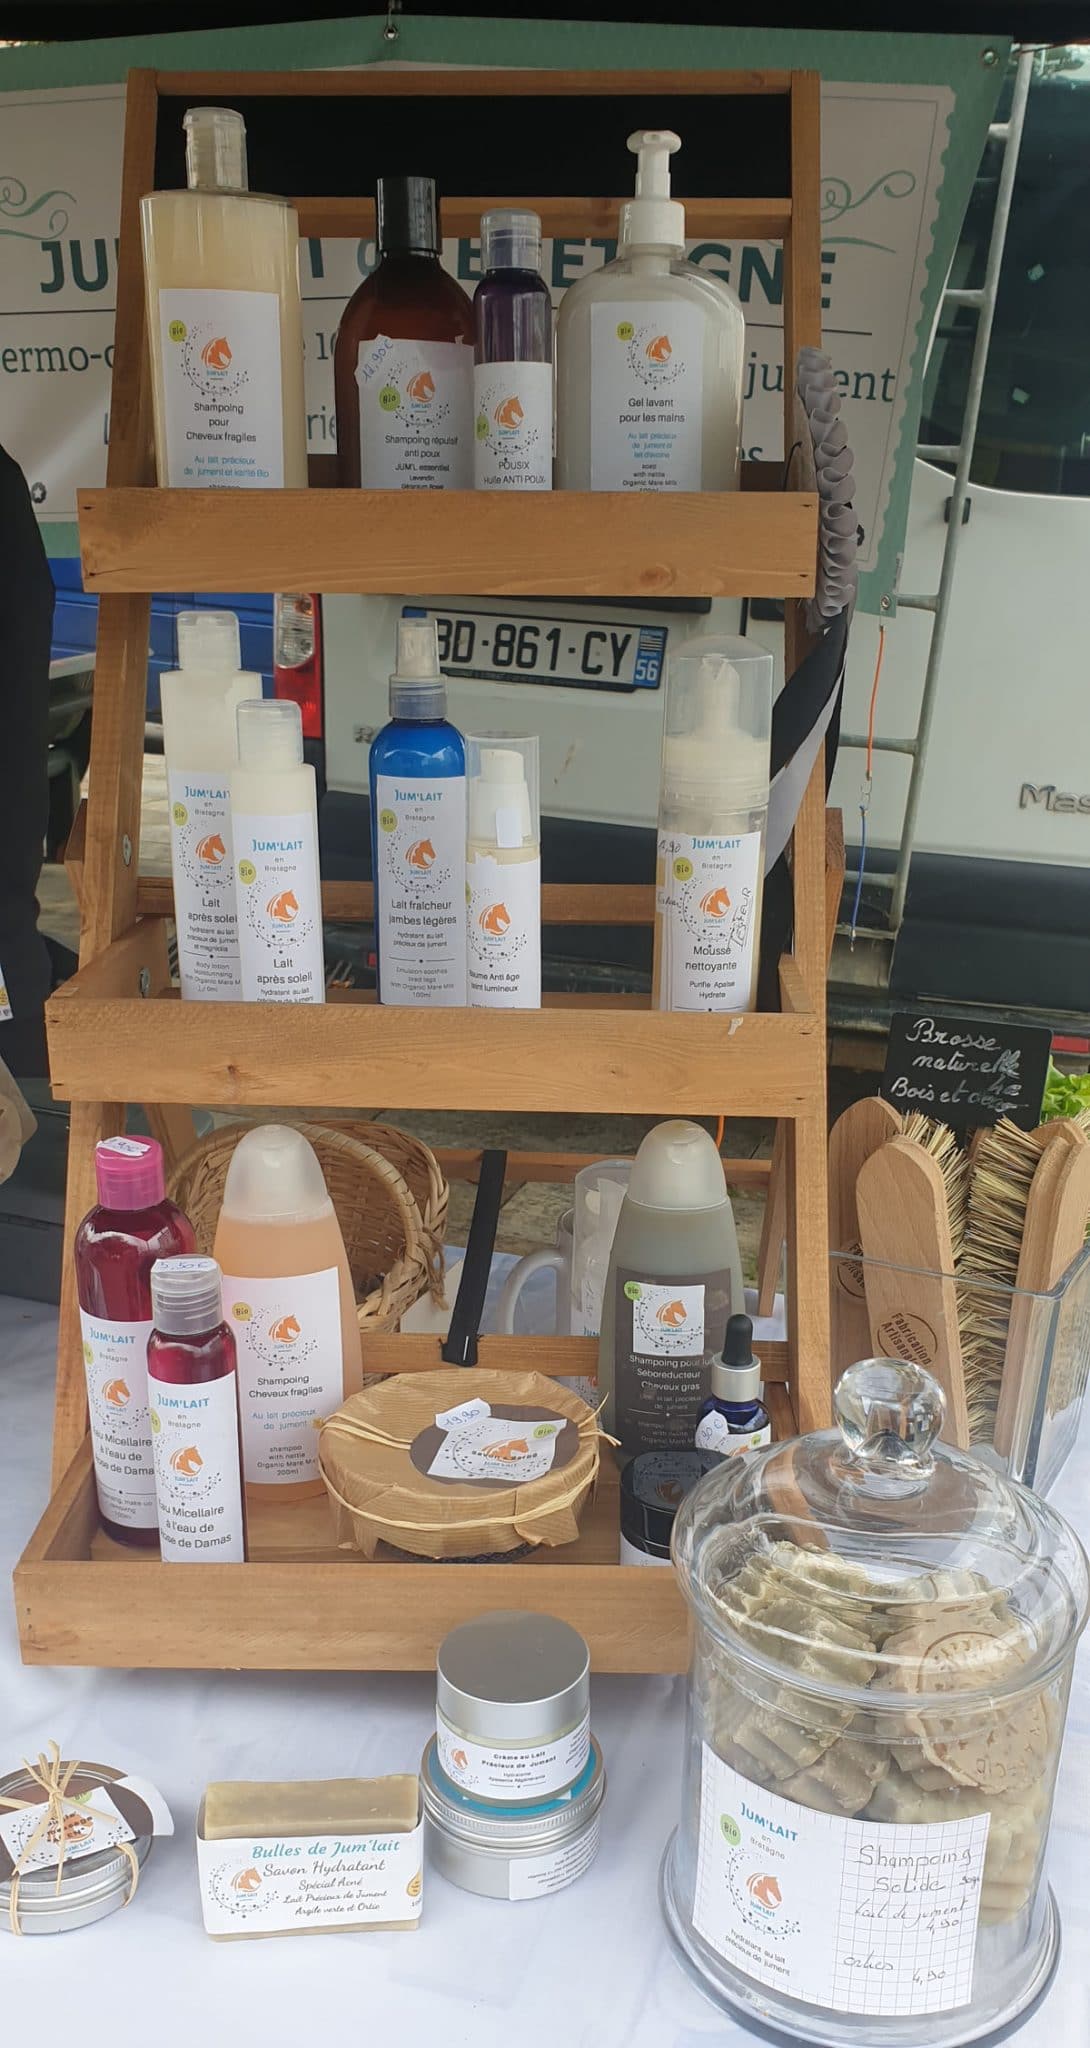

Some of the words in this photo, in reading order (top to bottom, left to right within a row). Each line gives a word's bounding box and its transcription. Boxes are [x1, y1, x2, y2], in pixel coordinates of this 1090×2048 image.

[194, 403, 244, 414] Shampoing
[628, 398, 644, 407] Gel
[646, 398, 673, 407] lavant
[209, 419, 229, 427] pour
[619, 414, 640, 424] pour
[643, 413, 656, 423] les
[658, 413, 685, 423] mains
[186, 432, 223, 441] Cheveux
[224, 432, 257, 443] fragiles
[385, 435, 430, 447] Shampoing
[431, 436, 458, 445] répulsif
[194, 455, 204, 464] Au
[404, 450, 419, 458] anti
[420, 451, 440, 459] poux
[498, 461, 529, 470] POUSIX
[502, 475, 523, 484] ANTI
[524, 476, 545, 484] POUX
[635, 659, 660, 681] 56
[394, 789, 443, 801] JUM'LAIT
[1019, 784, 1090, 814] Mas
[405, 814, 435, 822] Bretagne
[253, 839, 303, 852] JUM'LAIT
[691, 838, 741, 850] JUM'LAIT
[240, 868, 252, 877] Bio
[264, 864, 297, 873] Bretagne
[677, 864, 689, 873] Bio
[202, 898, 220, 907] Lait
[391, 899, 407, 909] Lait
[188, 911, 213, 924] après
[389, 915, 421, 927] jambes
[423, 916, 457, 927] légères
[693, 946, 732, 955] Mousse
[273, 958, 293, 969] Lait
[685, 961, 737, 973] nettoyante
[257, 975, 285, 986] après
[287, 971, 312, 984] soleil
[489, 972, 505, 980] Anti
[484, 983, 519, 993] lumineux
[905, 1018, 1000, 1050] Brosse
[891, 1077, 935, 1101] Bois
[90, 1328, 136, 1344] JUM'LAIT
[892, 1312, 932, 1365] Fabrication
[629, 1354, 678, 1368] Shampoing
[257, 1376, 310, 1386] Shampoing
[641, 1381, 679, 1391] Cheveux
[681, 1383, 700, 1392] gras
[248, 1389, 289, 1398] Cheveux
[290, 1386, 323, 1398] fragiles
[158, 1393, 210, 1409] JUM'LAIT
[266, 1410, 278, 1419] lait
[264, 1422, 274, 1430] de
[105, 1435, 152, 1447] Micellaire
[129, 1451, 142, 1461] de
[111, 1463, 122, 1474] de
[124, 1465, 154, 1475] Dama
[172, 1505, 225, 1517] Micellaire
[166, 1520, 172, 1529] à
[175, 1521, 198, 1533] l'eau
[200, 1523, 214, 1533] de
[179, 1538, 192, 1548] de
[194, 1534, 232, 1549] Damas
[741, 1802, 798, 1842] JUM'LAIT
[723, 1822, 738, 1837] Bio
[761, 1834, 772, 1843] en
[252, 1845, 301, 1859] Bulles
[308, 1842, 327, 1855] de
[331, 1839, 400, 1858] Jum'lait
[750, 1837, 785, 1860] Bretagne
[263, 1863, 308, 1877] Savon
[312, 1859, 386, 1874] Hydratant
[854, 1845, 971, 1881] Shampoing
[298, 1878, 335, 1892] Spécial
[338, 1877, 362, 1888] Acné
[873, 1872, 946, 1893] Solide
[305, 1893, 341, 1903] Précieux
[343, 1891, 354, 1899] de
[356, 1889, 388, 1899] Jument
